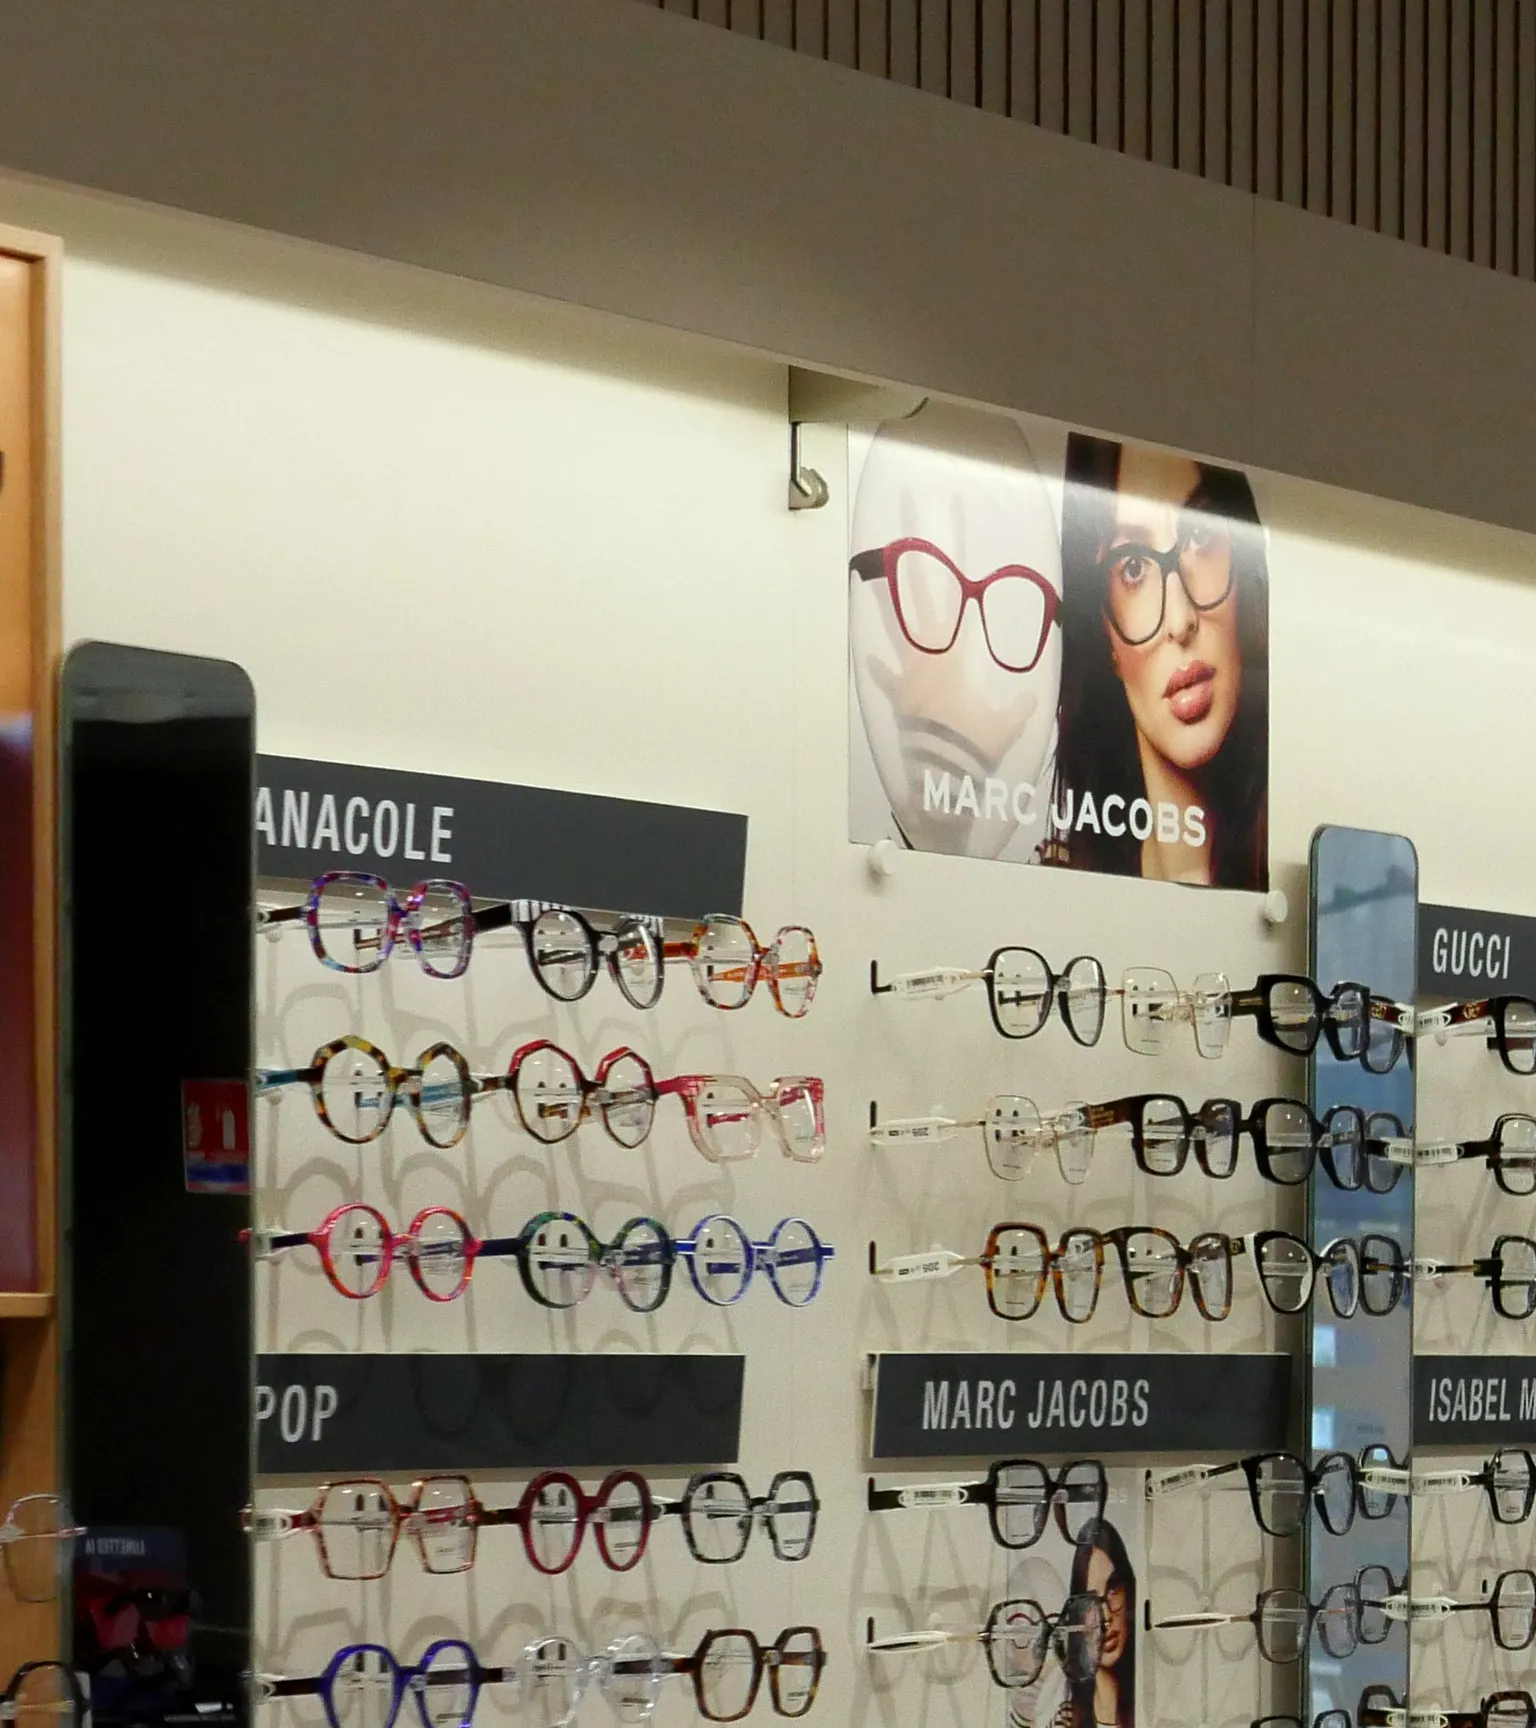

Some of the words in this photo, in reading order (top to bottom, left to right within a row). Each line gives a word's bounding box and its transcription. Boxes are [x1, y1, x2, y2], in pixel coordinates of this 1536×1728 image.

[922, 768, 1038, 826] MARC
[1050, 787, 1208, 848] JACOBS
[1432, 927, 1511, 980] GUCCI
[254, 1384, 338, 1443] POP
[922, 1379, 1017, 1430] MARC
[1027, 1379, 1150, 1429] JACOBS
[1428, 1377, 1512, 1423] ISABEL
